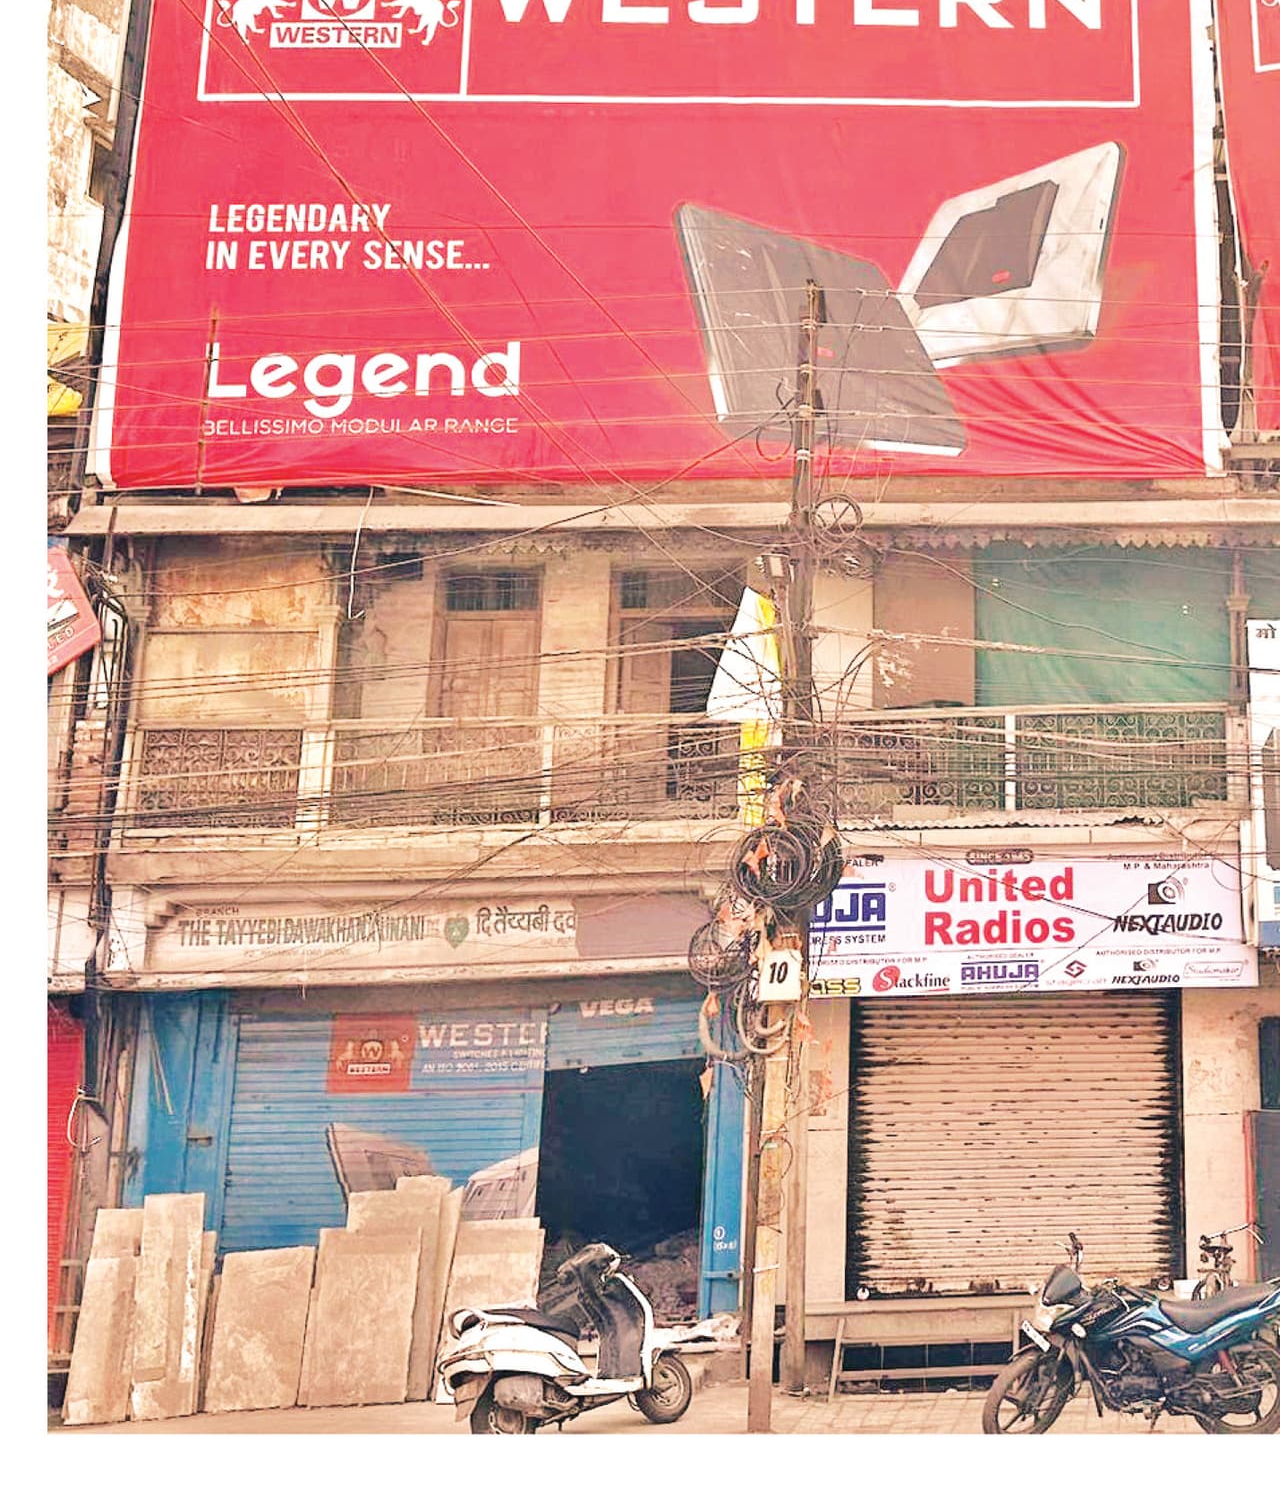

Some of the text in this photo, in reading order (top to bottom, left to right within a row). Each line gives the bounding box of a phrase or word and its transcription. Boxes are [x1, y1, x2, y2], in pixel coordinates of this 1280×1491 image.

[275, 26, 398, 45] WESTERN
[208, 203, 391, 233] LEGENDARY
[205, 240, 490, 270] IN EVERY SENSE...
[205, 340, 521, 419] Legend
[203, 417, 519, 437] BELLISSIMO MODULAR RANGE
[924, 865, 1074, 903] United
[178, 919, 211, 947] THE
[844, 934, 886, 944] SYSTEM
[924, 910, 1076, 946] Radios
[769, 961, 789, 984] 10
[961, 963, 1039, 981] AHUJA
[579, 997, 655, 1018] VEGA
